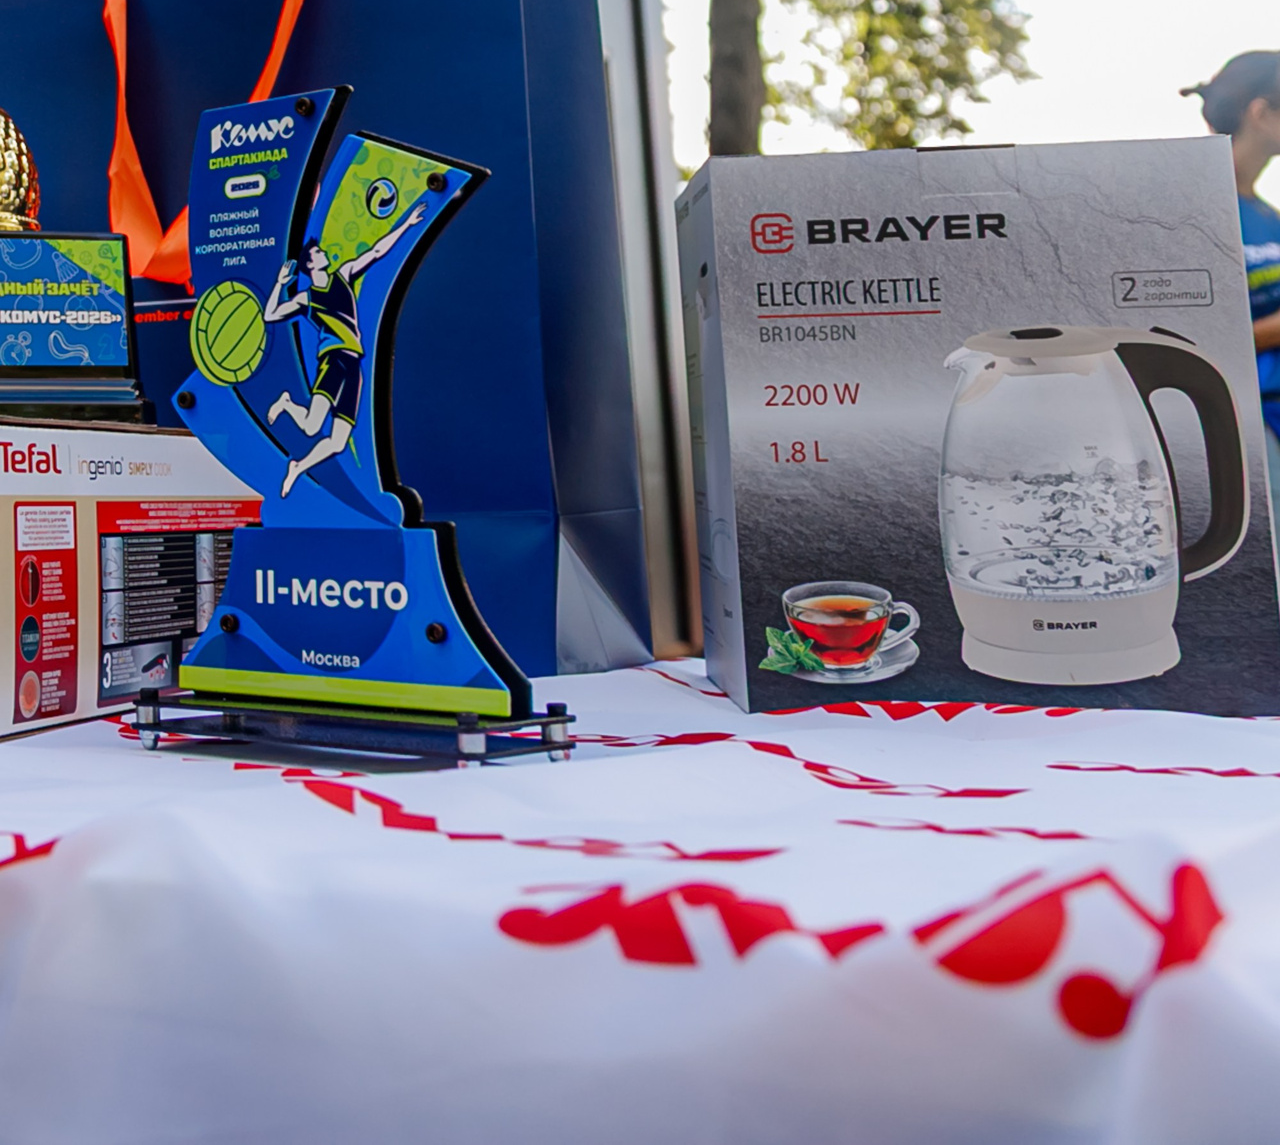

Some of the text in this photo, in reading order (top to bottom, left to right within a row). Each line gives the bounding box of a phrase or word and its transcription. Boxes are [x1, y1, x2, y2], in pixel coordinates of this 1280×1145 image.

[210, 116, 294, 154] Комус
[209, 147, 288, 169] СПАРТАКИАДА
[209, 207, 259, 223] ПЛЯЖНЫЙ
[209, 223, 260, 238] ВОЛЕЙБОЛ
[806, 213, 1008, 245] BRAYER
[195, 237, 275, 254] КОРПОРАТИВНАЯ
[222, 256, 247, 267] ЛИГА
[47, 281, 100, 296] ЗАЧЁТ
[1120, 277, 1138, 302] 2
[1143, 277, 1172, 288] года
[757, 277, 941, 307] ELECTRIC KETTLE
[1144, 291, 1207, 302] гарантии
[133, 310, 180, 323] ember
[759, 325, 856, 342] BR1045BN
[764, 383, 860, 406] 2200 W
[770, 440, 829, 463] 1.8 L
[129, 462, 153, 475] SIMPLY
[1047, 621, 1098, 630] BRAYER
[301, 649, 361, 668] Москва
[102, 652, 112, 689] 3
